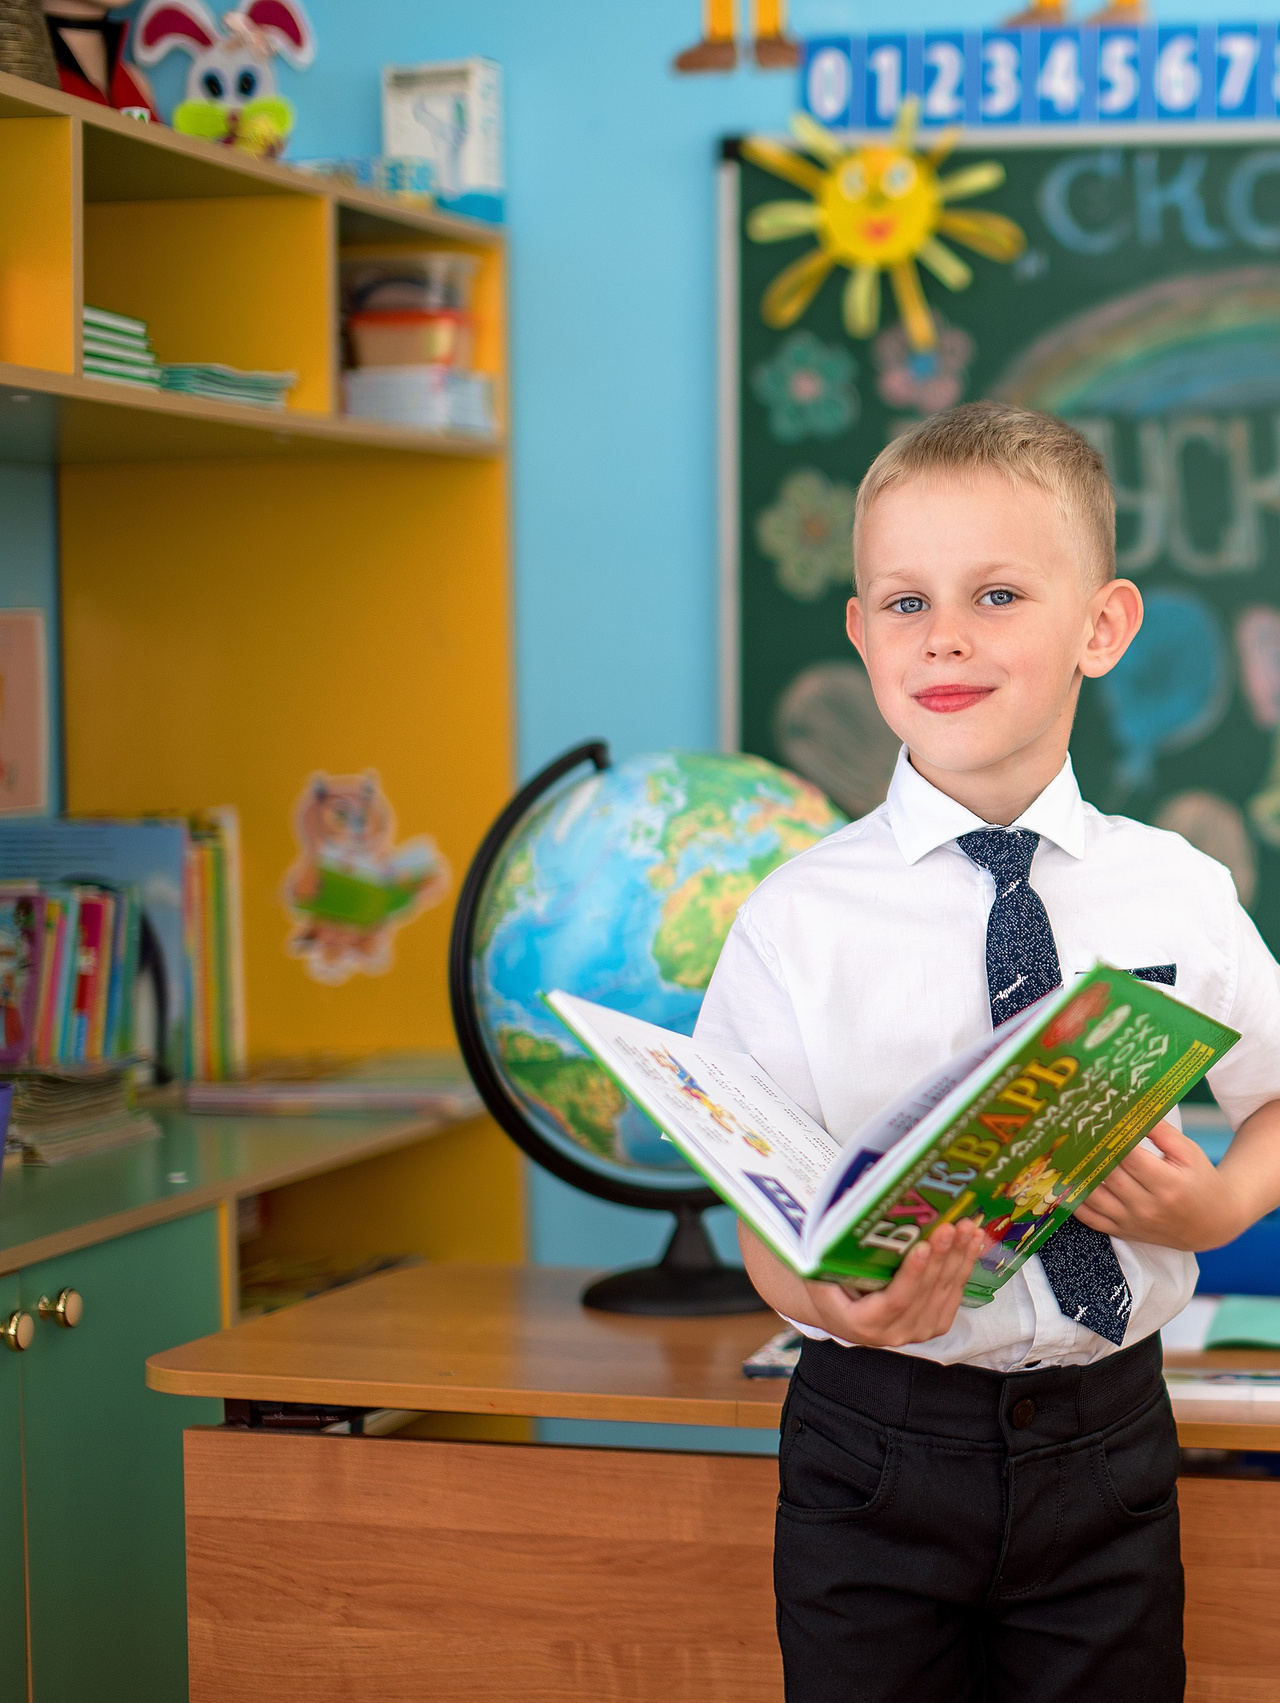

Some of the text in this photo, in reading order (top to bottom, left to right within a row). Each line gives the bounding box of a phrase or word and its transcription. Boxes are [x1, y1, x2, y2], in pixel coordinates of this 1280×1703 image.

[808, 46, 850, 119] 0
[870, 44, 903, 117] 1
[923, 43, 963, 116] 2
[981, 40, 1019, 115] 3
[1038, 37, 1082, 114] 4
[1099, 37, 1138, 113] 5
[1154, 35, 1198, 112] 6
[1217, 34, 1259, 109] 7
[1109, 1021, 1156, 1065] ОХ
[1120, 1032, 1178, 1086] АУ
[1126, 1031, 1165, 1067] СА
[1058, 1063, 1125, 1128] РО-ЗА
[1066, 1126, 1119, 1179] СОЧЕТАНИЕ
[1119, 1046, 1196, 1123] ТРАДИЦИОННОЙ
[1069, 1087, 1120, 1133] АМ
[1085, 1073, 1151, 1137] ЛУ-НА
[1127, 1049, 1203, 1126] ОРИГИНАЛЬНОЙ
[859, 1052, 1082, 1255] БУКВАРЬ
[981, 1086, 1077, 1179] МА-МА
[1070, 1109, 1157, 1196] ЛОГОПЕДИЧЕСКОЙ
[1159, 1053, 1210, 1105] МЕТОДИКИ
